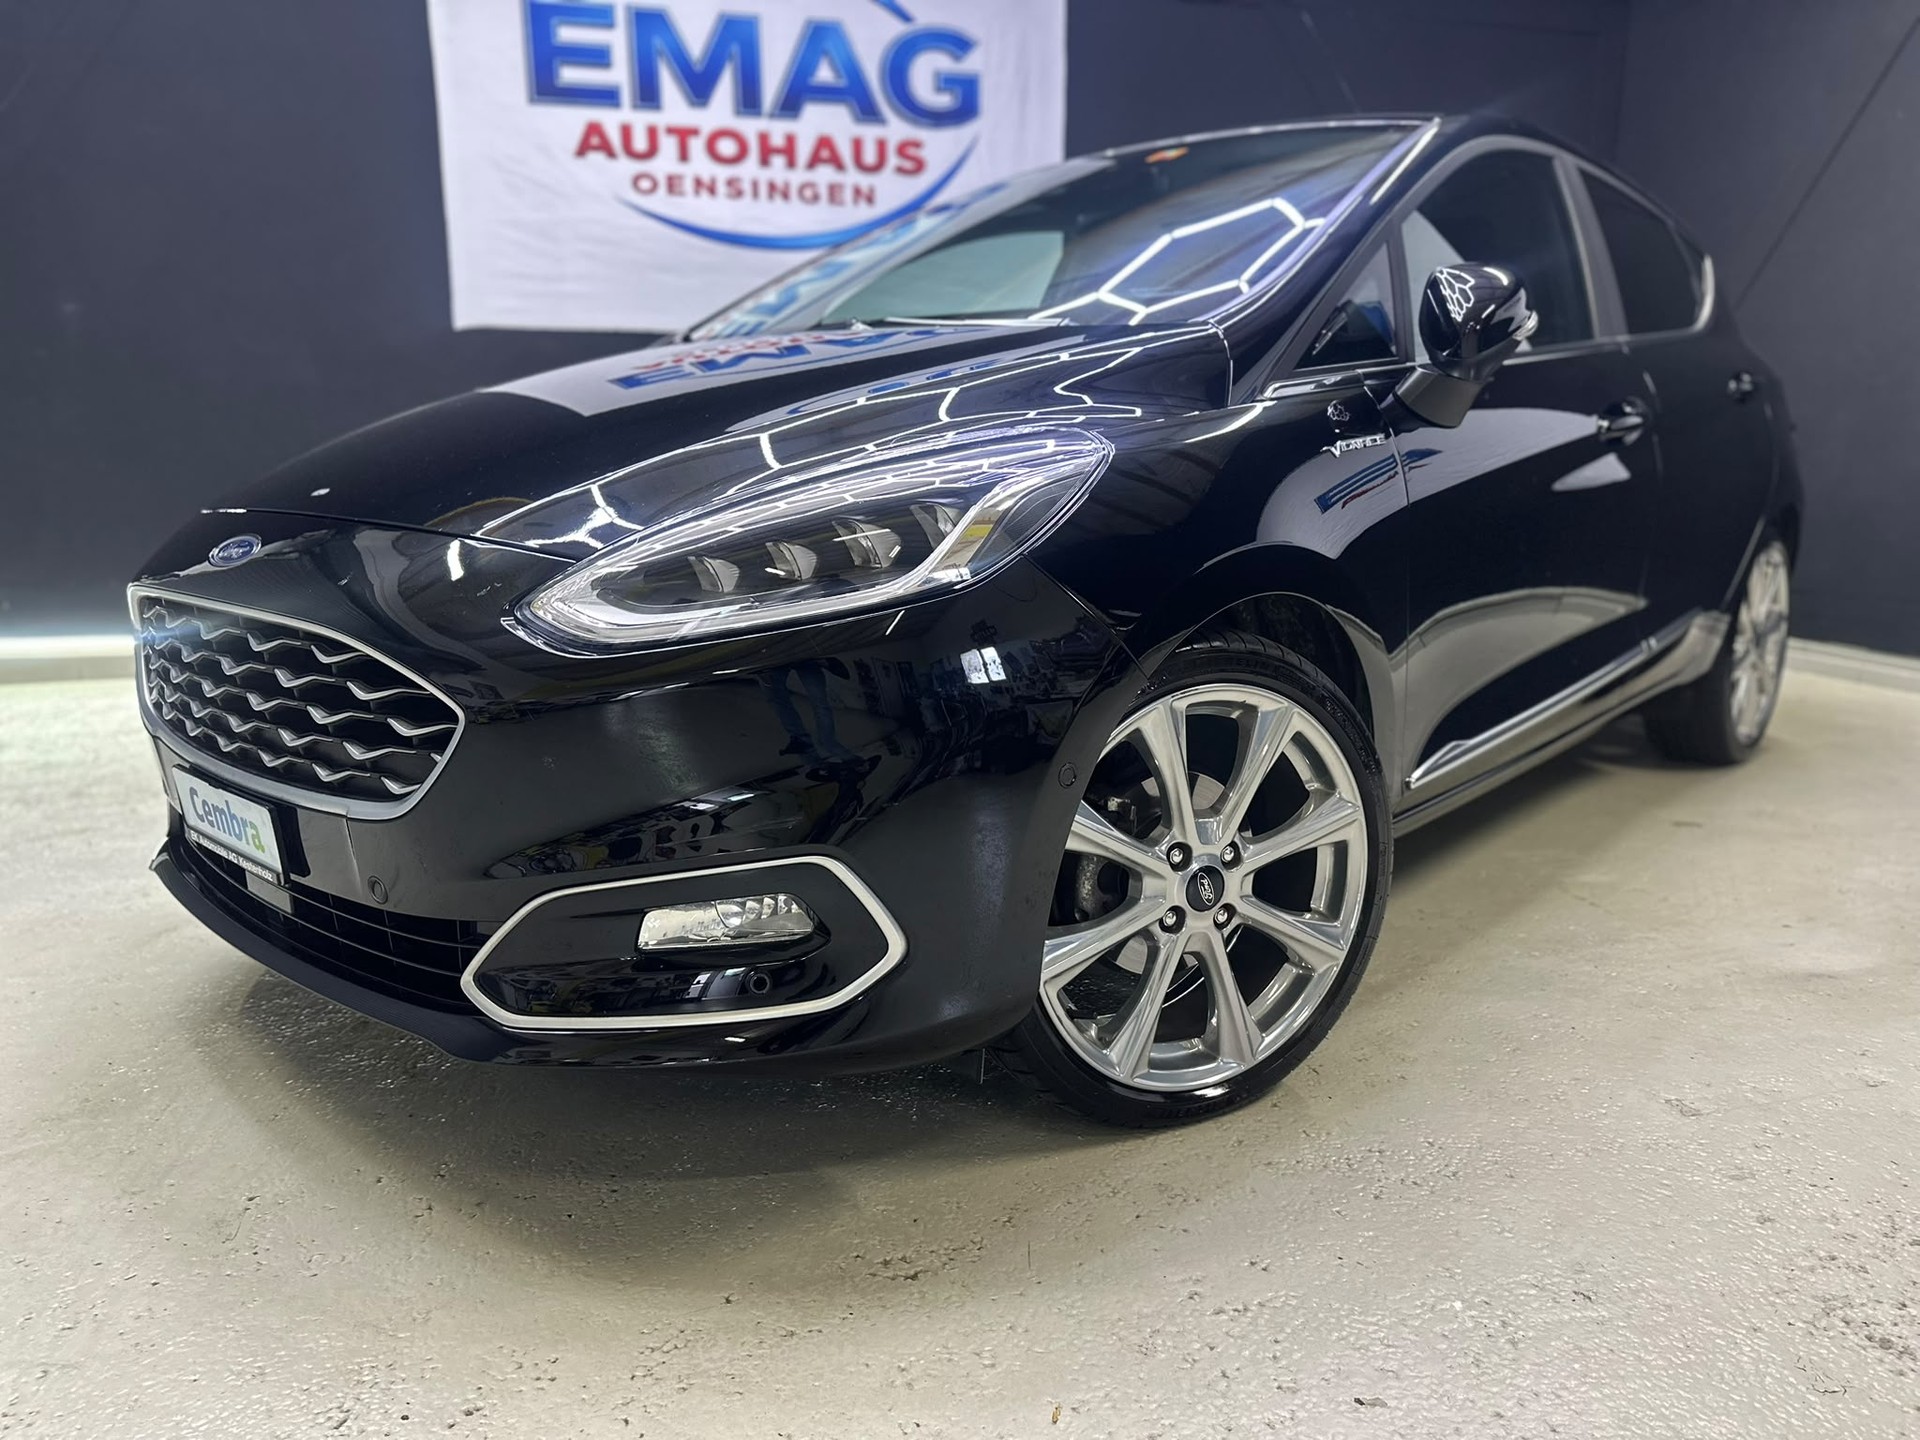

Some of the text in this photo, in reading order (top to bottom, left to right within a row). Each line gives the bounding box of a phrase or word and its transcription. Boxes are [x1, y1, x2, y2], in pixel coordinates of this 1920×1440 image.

[520, 0, 981, 130] EMAG
[574, 120, 927, 176] AUTOHAUS
[632, 172, 877, 208] OENSINGEN
[189, 786, 266, 854] Cembra
